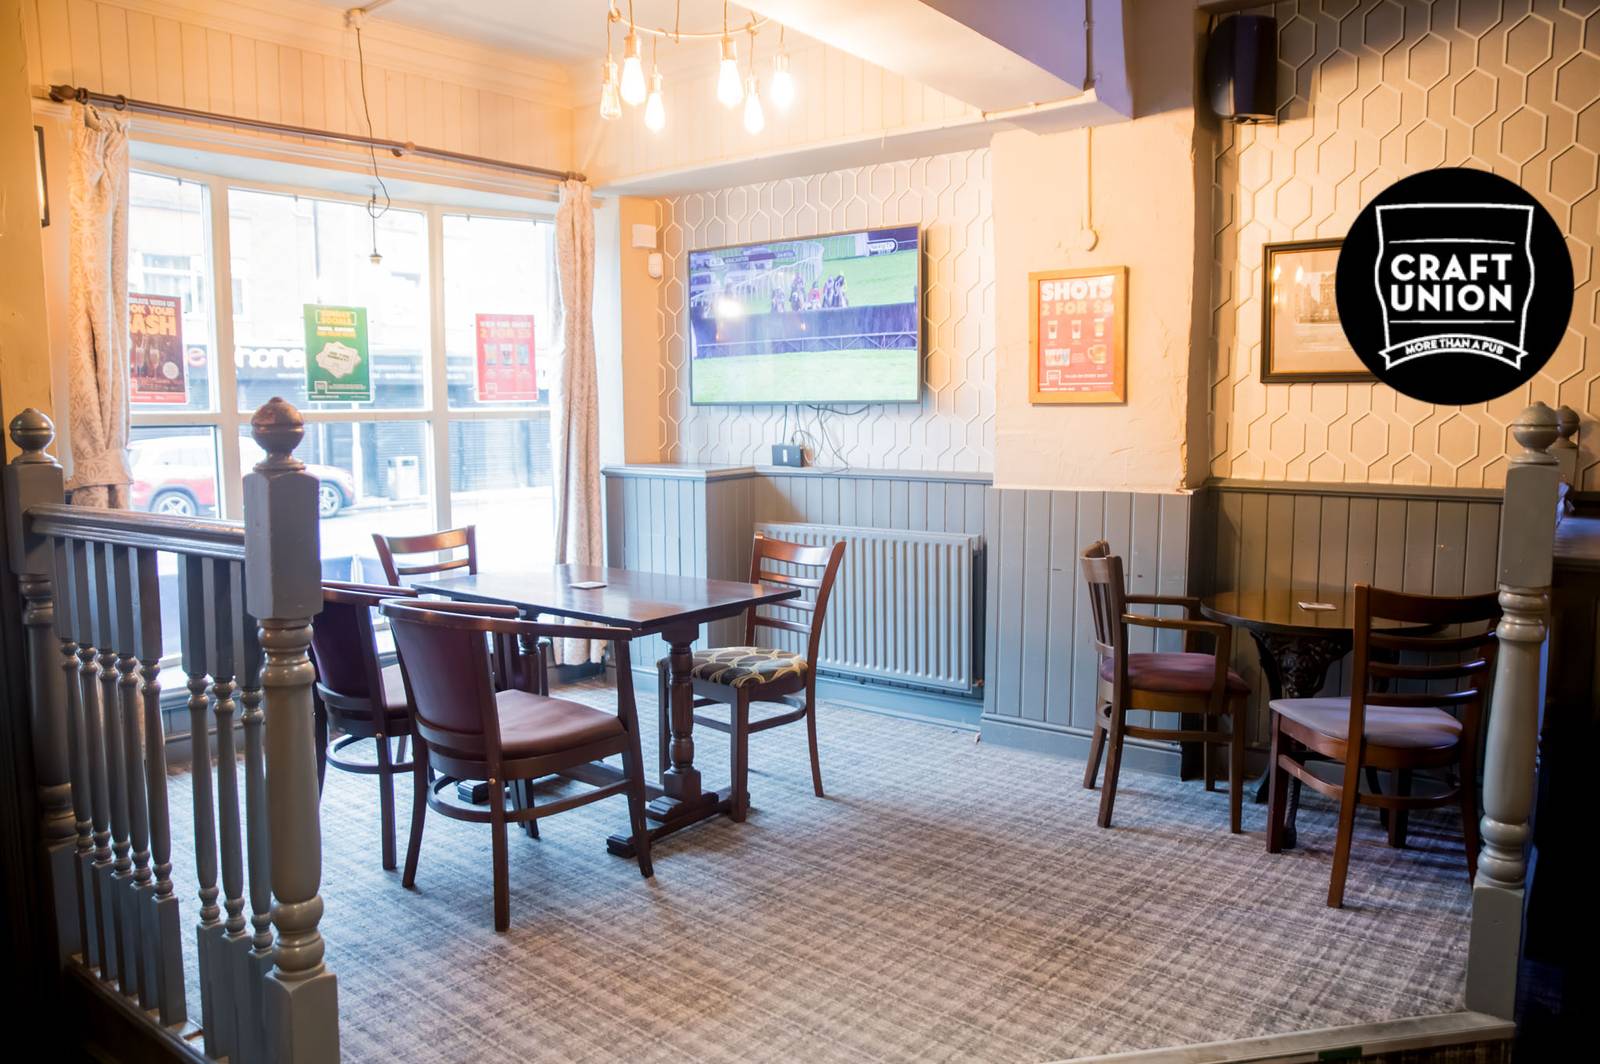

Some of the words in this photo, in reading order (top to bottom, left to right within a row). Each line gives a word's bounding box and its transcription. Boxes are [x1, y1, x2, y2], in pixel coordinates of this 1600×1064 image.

[1041, 279, 1113, 301] SHOTS
[149, 306, 175, 316] YOUR
[1041, 303, 1051, 317] 2
[1056, 301, 1087, 316] FOR
